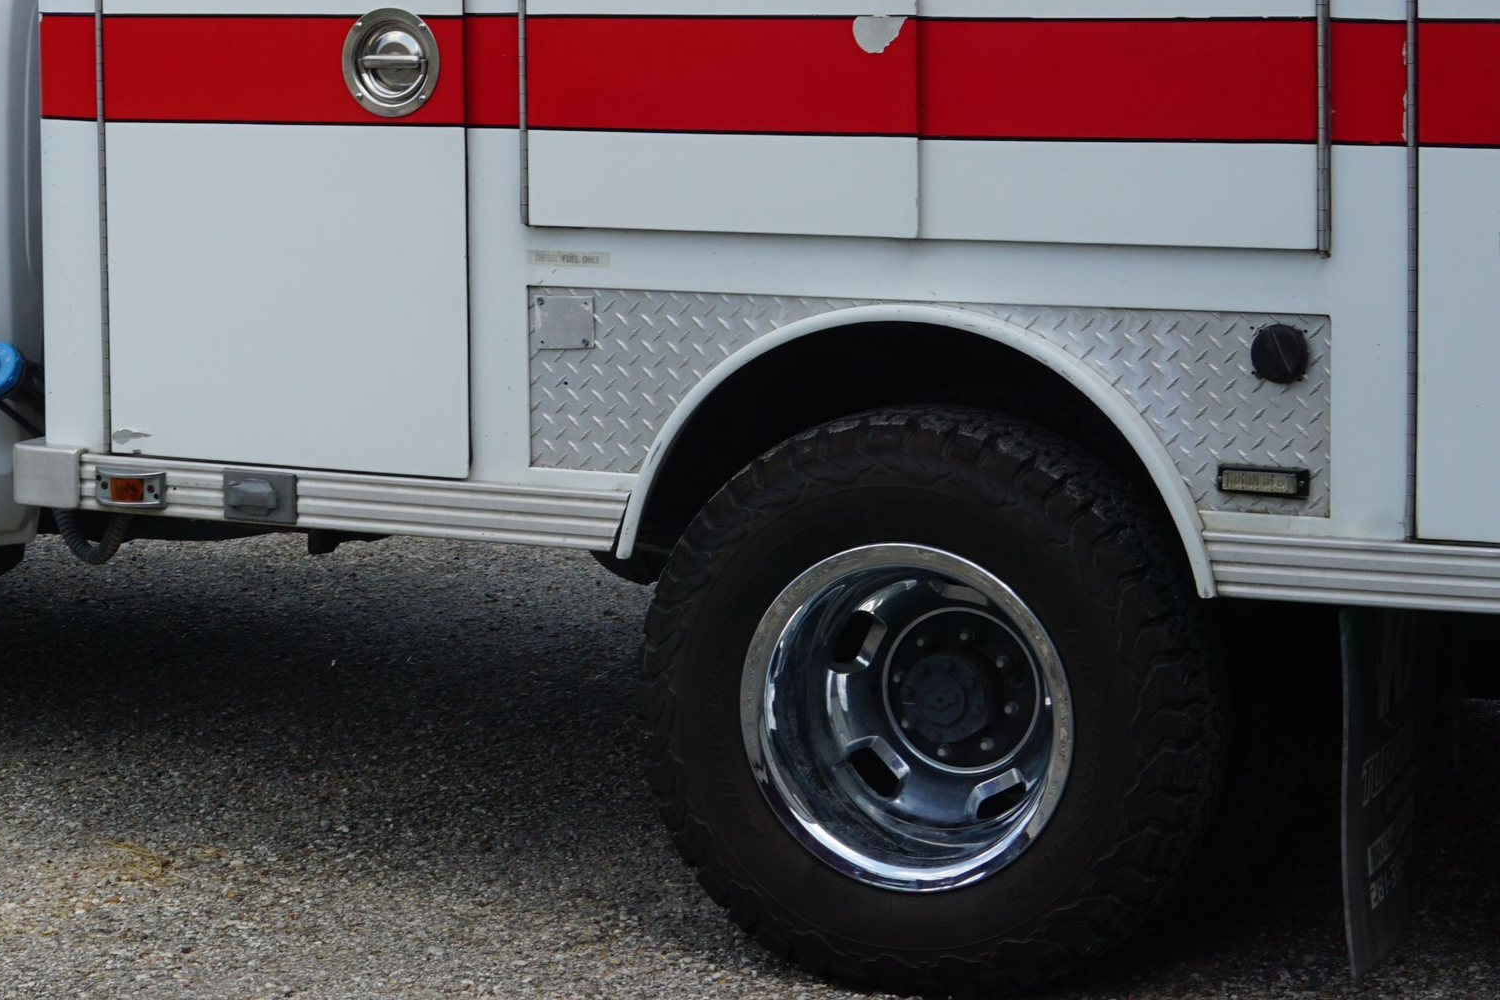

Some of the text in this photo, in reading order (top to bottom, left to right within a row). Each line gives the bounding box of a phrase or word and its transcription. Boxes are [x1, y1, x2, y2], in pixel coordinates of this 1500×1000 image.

[536, 254, 600, 264] DIESEL FUEL ONLY
